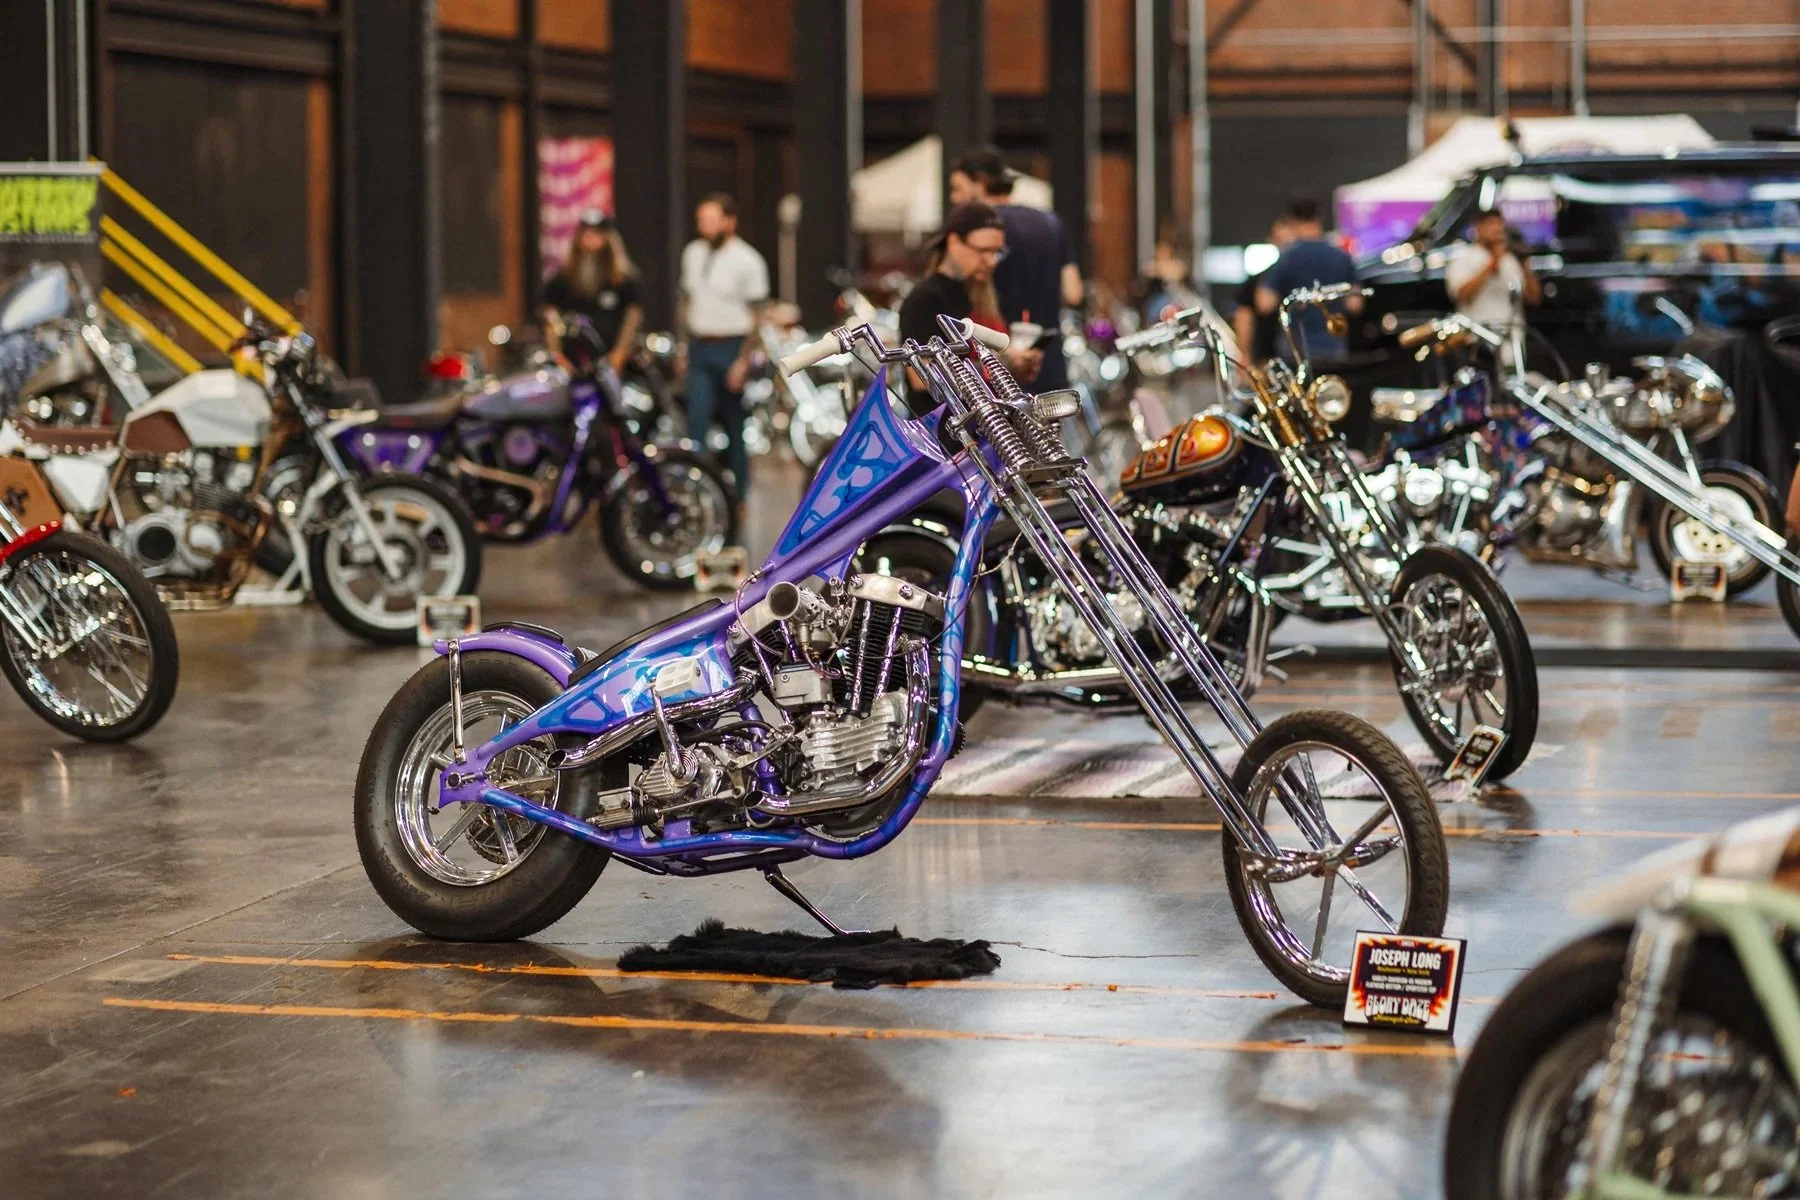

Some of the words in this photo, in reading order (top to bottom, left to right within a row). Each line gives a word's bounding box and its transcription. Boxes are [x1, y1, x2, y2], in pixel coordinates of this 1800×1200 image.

[1369, 948, 1410, 967] JOSEPH
[1411, 951, 1441, 970] LONG
[1365, 995, 1401, 1017] GLORY
[1401, 997, 1431, 1022] DAZE
